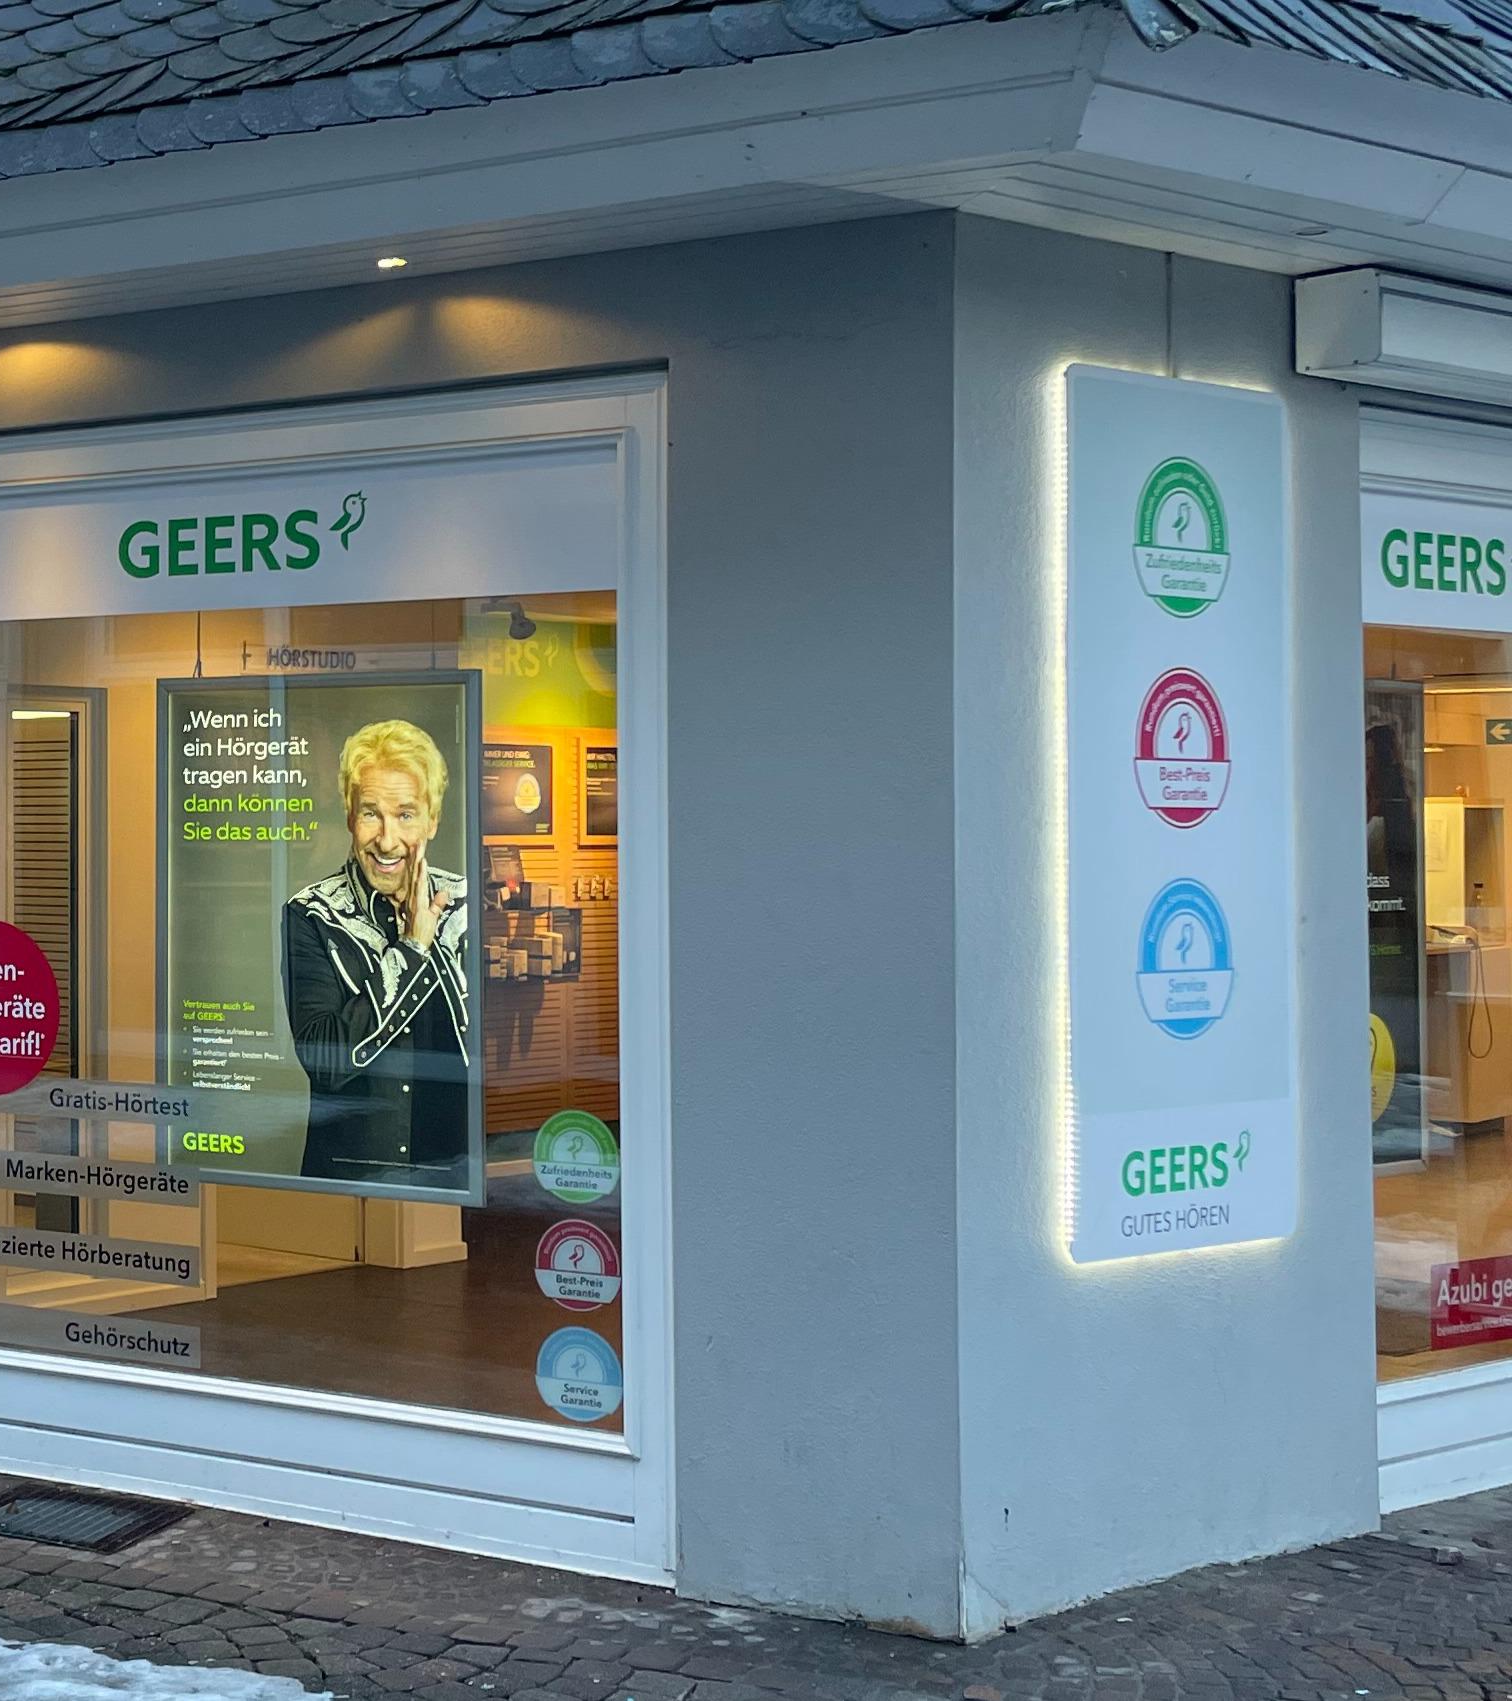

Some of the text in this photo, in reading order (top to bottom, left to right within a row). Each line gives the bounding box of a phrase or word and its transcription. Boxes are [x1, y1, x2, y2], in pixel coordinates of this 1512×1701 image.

[118, 509, 321, 579] GEERS
[1145, 553, 1222, 574] Zufriedenheits
[1381, 528, 1506, 597] GEERS
[1161, 574, 1207, 592] Garantie
[267, 643, 356, 669] HÖRSTUDIO
[183, 708, 282, 733] „Wenn ich
[183, 737, 309, 760] ein Hörgerät
[183, 766, 308, 788] tragen kann,
[1159, 767, 1210, 782] Best-Preis
[183, 793, 313, 813] dann können
[1162, 784, 1208, 801] Garantie
[183, 822, 212, 841] Sie
[216, 822, 251, 841] das
[1168, 978, 1208, 993] Service
[183, 1000, 255, 1011] Vertrauen auch Sie
[183, 1012, 196, 1020] auf
[49, 1088, 189, 1117] Gratis-Hörtest
[183, 1131, 245, 1155] GEERS
[6, 1158, 189, 1195] Marken-Hörgeräte
[540, 1164, 613, 1179] Zufriedenheits
[1122, 1142, 1229, 1197] GEERS
[555, 1177, 598, 1190] Garantie
[1121, 1203, 1230, 1237] GUTES HÖREN
[62, 1241, 190, 1279] Hörberatung
[556, 1274, 603, 1288] Best-Preis
[1437, 1273, 1488, 1307] Azubi
[558, 1286, 600, 1299] Garantie
[65, 1323, 190, 1357] Gehörschutz
[563, 1383, 599, 1396] Service
[560, 1394, 602, 1409] Garantie
